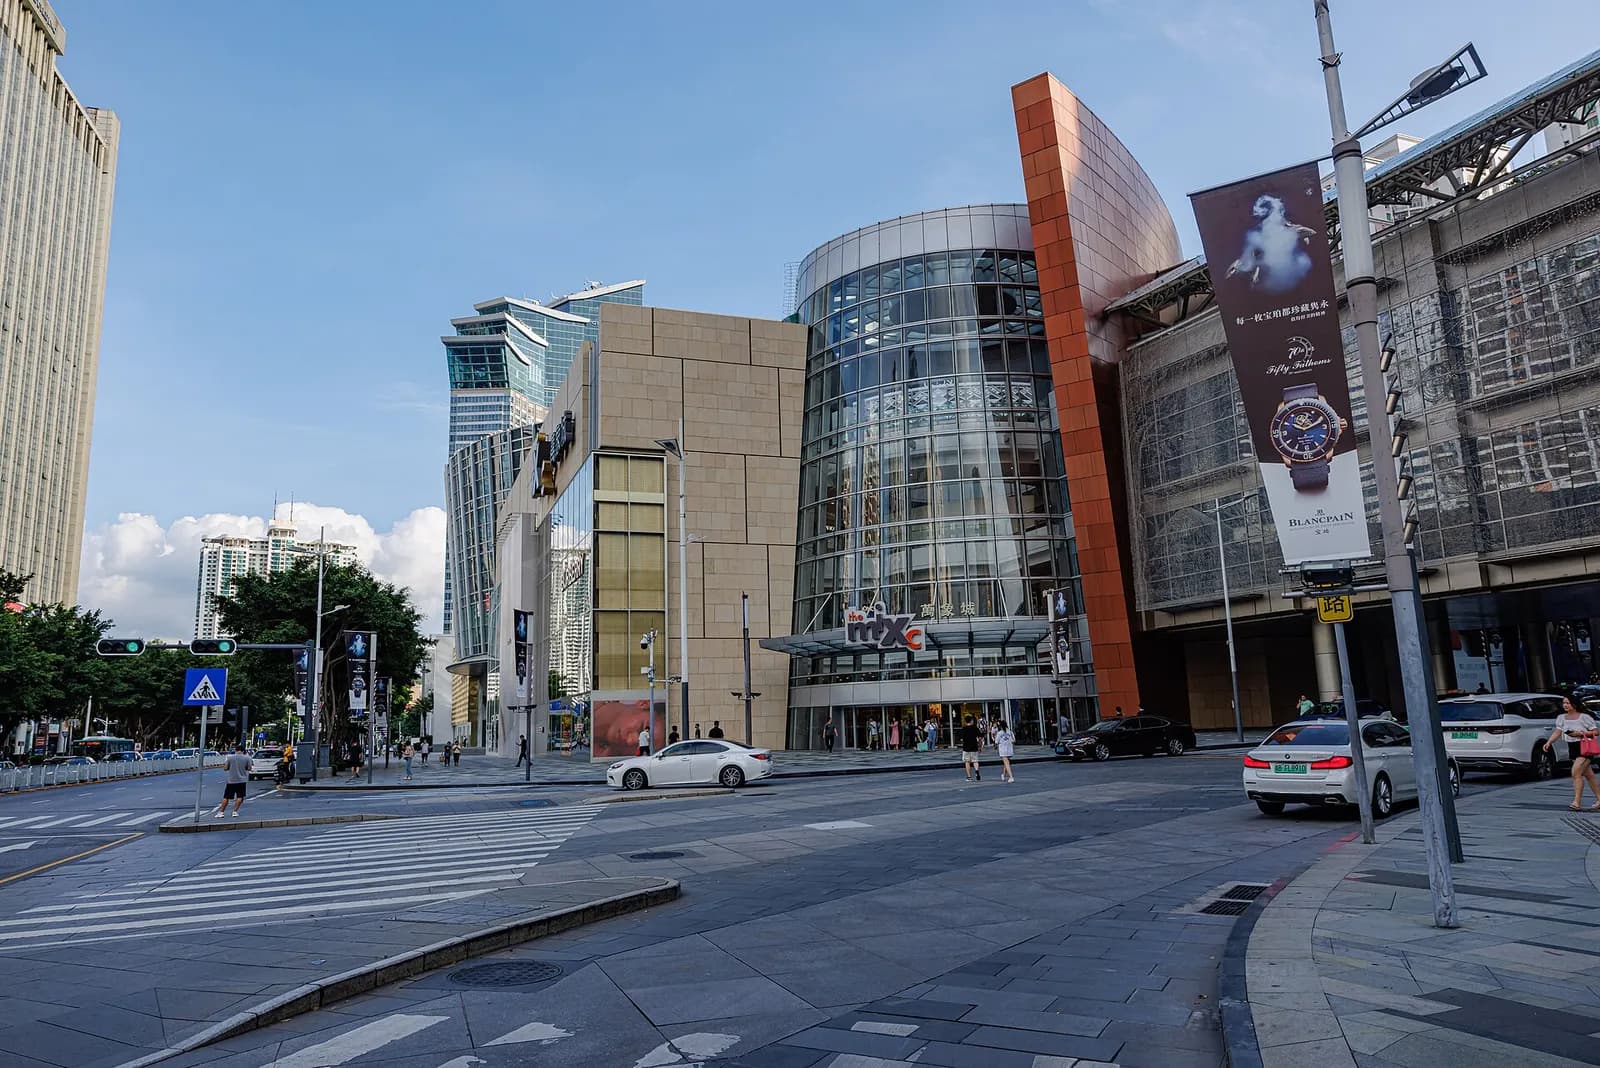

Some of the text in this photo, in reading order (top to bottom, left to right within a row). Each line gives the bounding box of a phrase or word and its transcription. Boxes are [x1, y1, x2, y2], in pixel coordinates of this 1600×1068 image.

[1266, 364, 1290, 375] Fifty
[1292, 358, 1332, 370] Fathoms
[1289, 512, 1354, 527] BLANCPAIN
[848, 611, 864, 622] the
[920, 601, 976, 618] 萬象城
